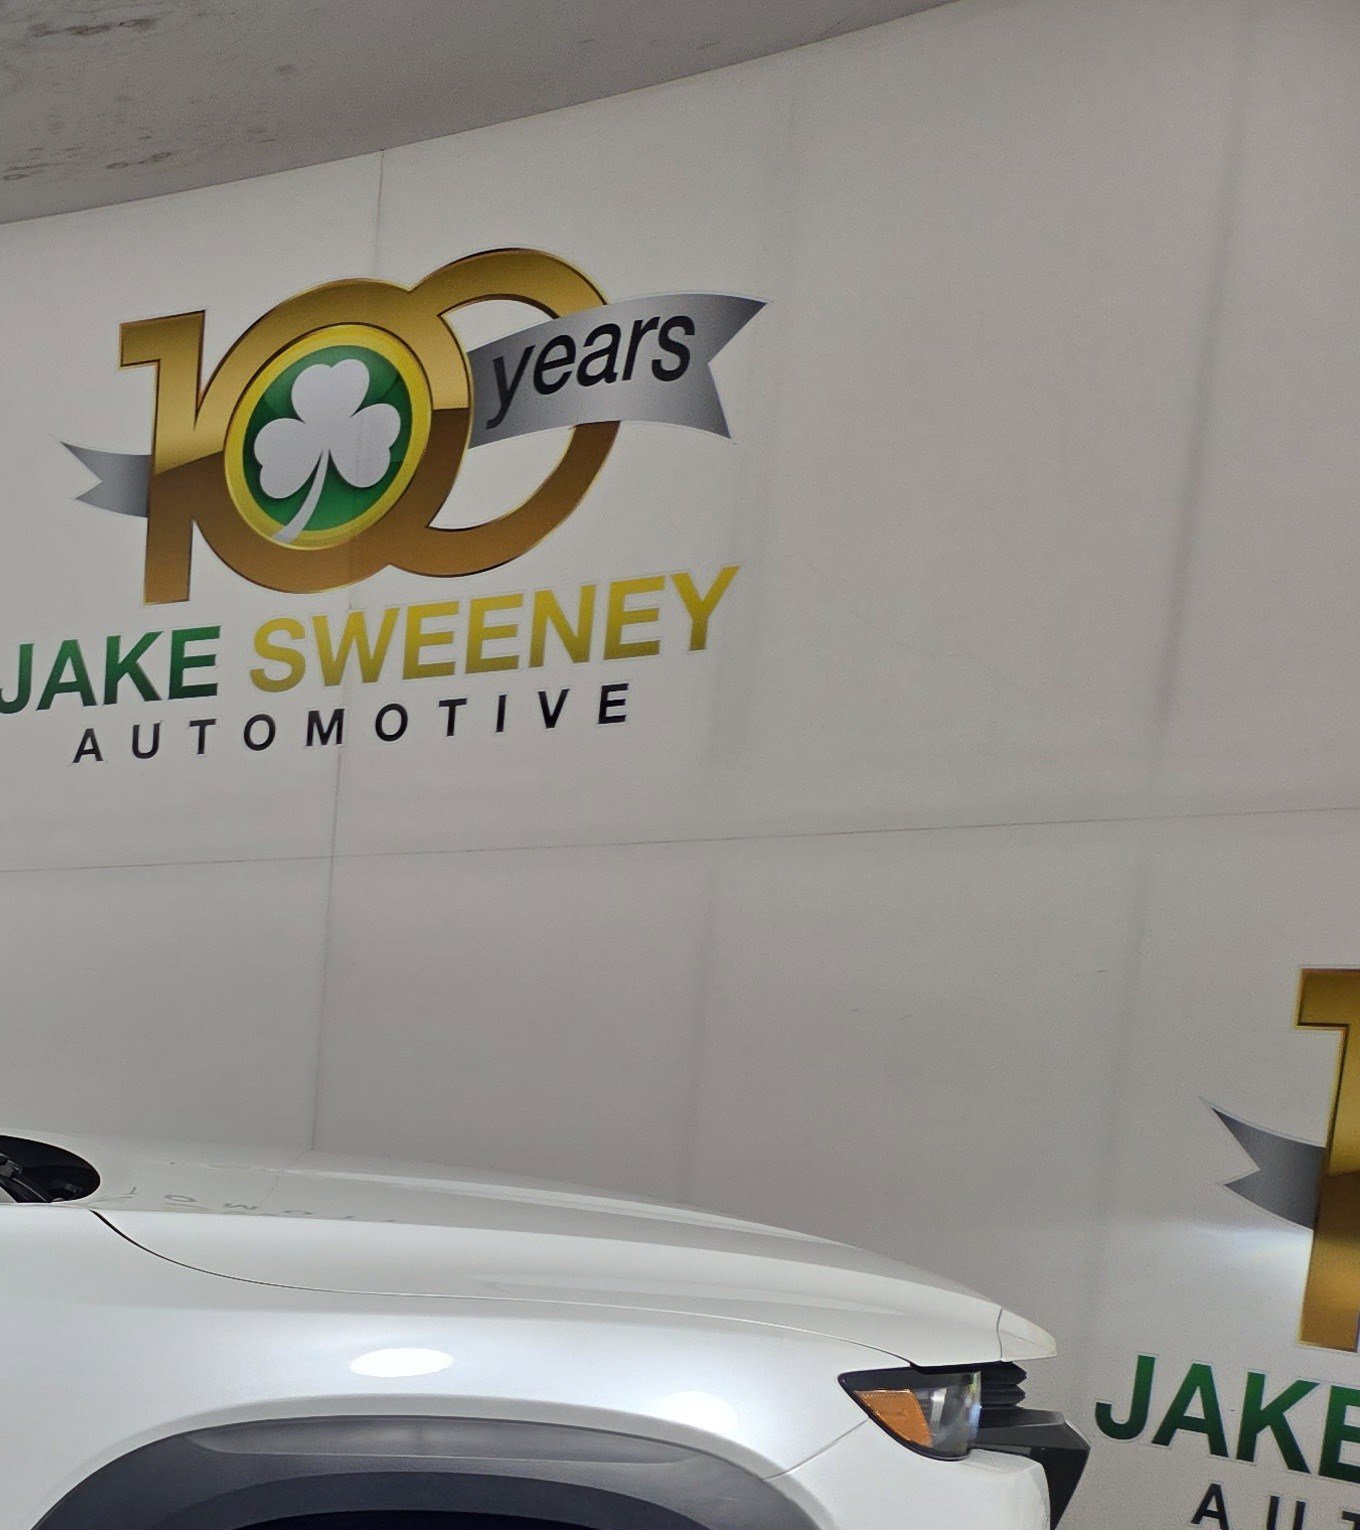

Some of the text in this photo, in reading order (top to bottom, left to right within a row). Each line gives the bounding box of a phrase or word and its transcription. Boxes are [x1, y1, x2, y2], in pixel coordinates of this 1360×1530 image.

[119, 247, 621, 605] 100
[487, 314, 696, 430] years
[248, 565, 740, 693] SWEENEY
[72, 682, 631, 765] AUTOMOTIVE
